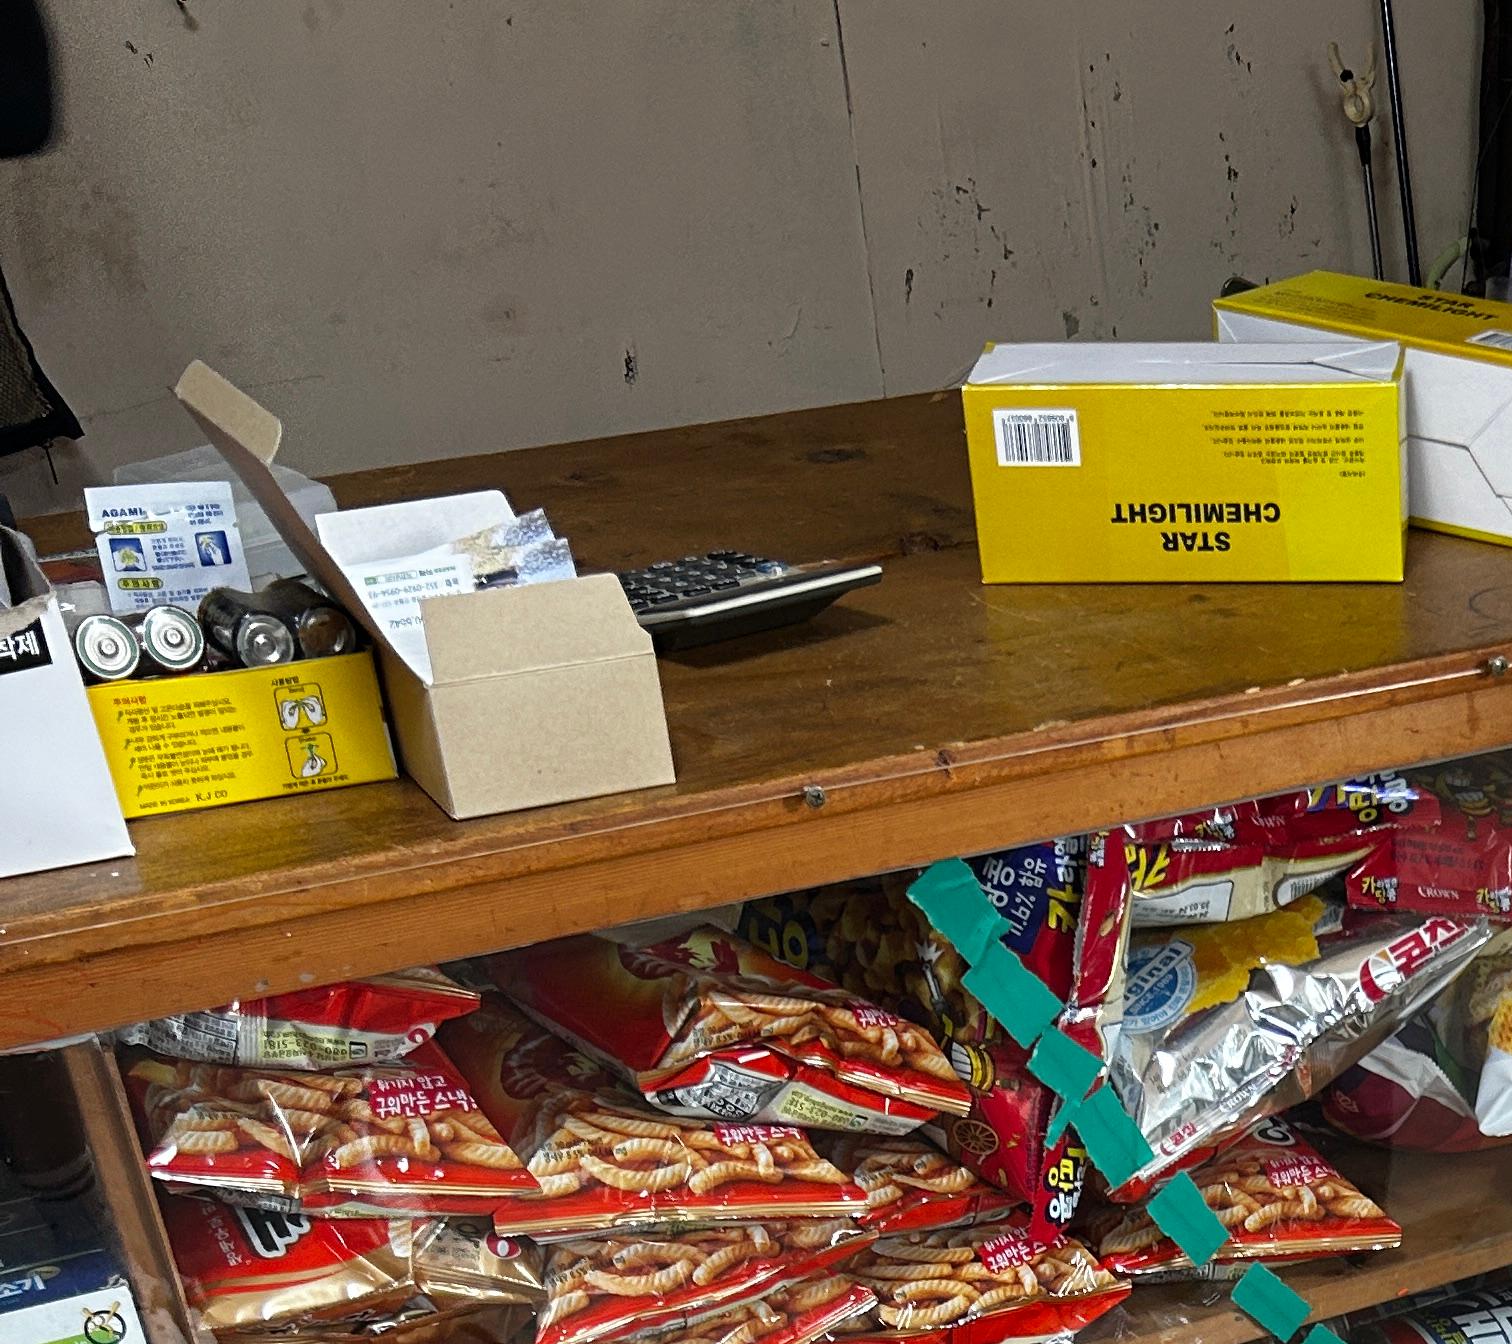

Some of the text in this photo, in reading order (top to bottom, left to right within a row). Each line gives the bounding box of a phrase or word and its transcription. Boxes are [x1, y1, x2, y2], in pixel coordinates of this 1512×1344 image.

[1365, 291, 1499, 322] CHEMILIGHT
[1421, 293, 1474, 309] STAR
[1110, 503, 1282, 525] CHEMILIGHT
[1162, 531, 1231, 553] STAR
[1417, 885, 1459, 900] CROWN
